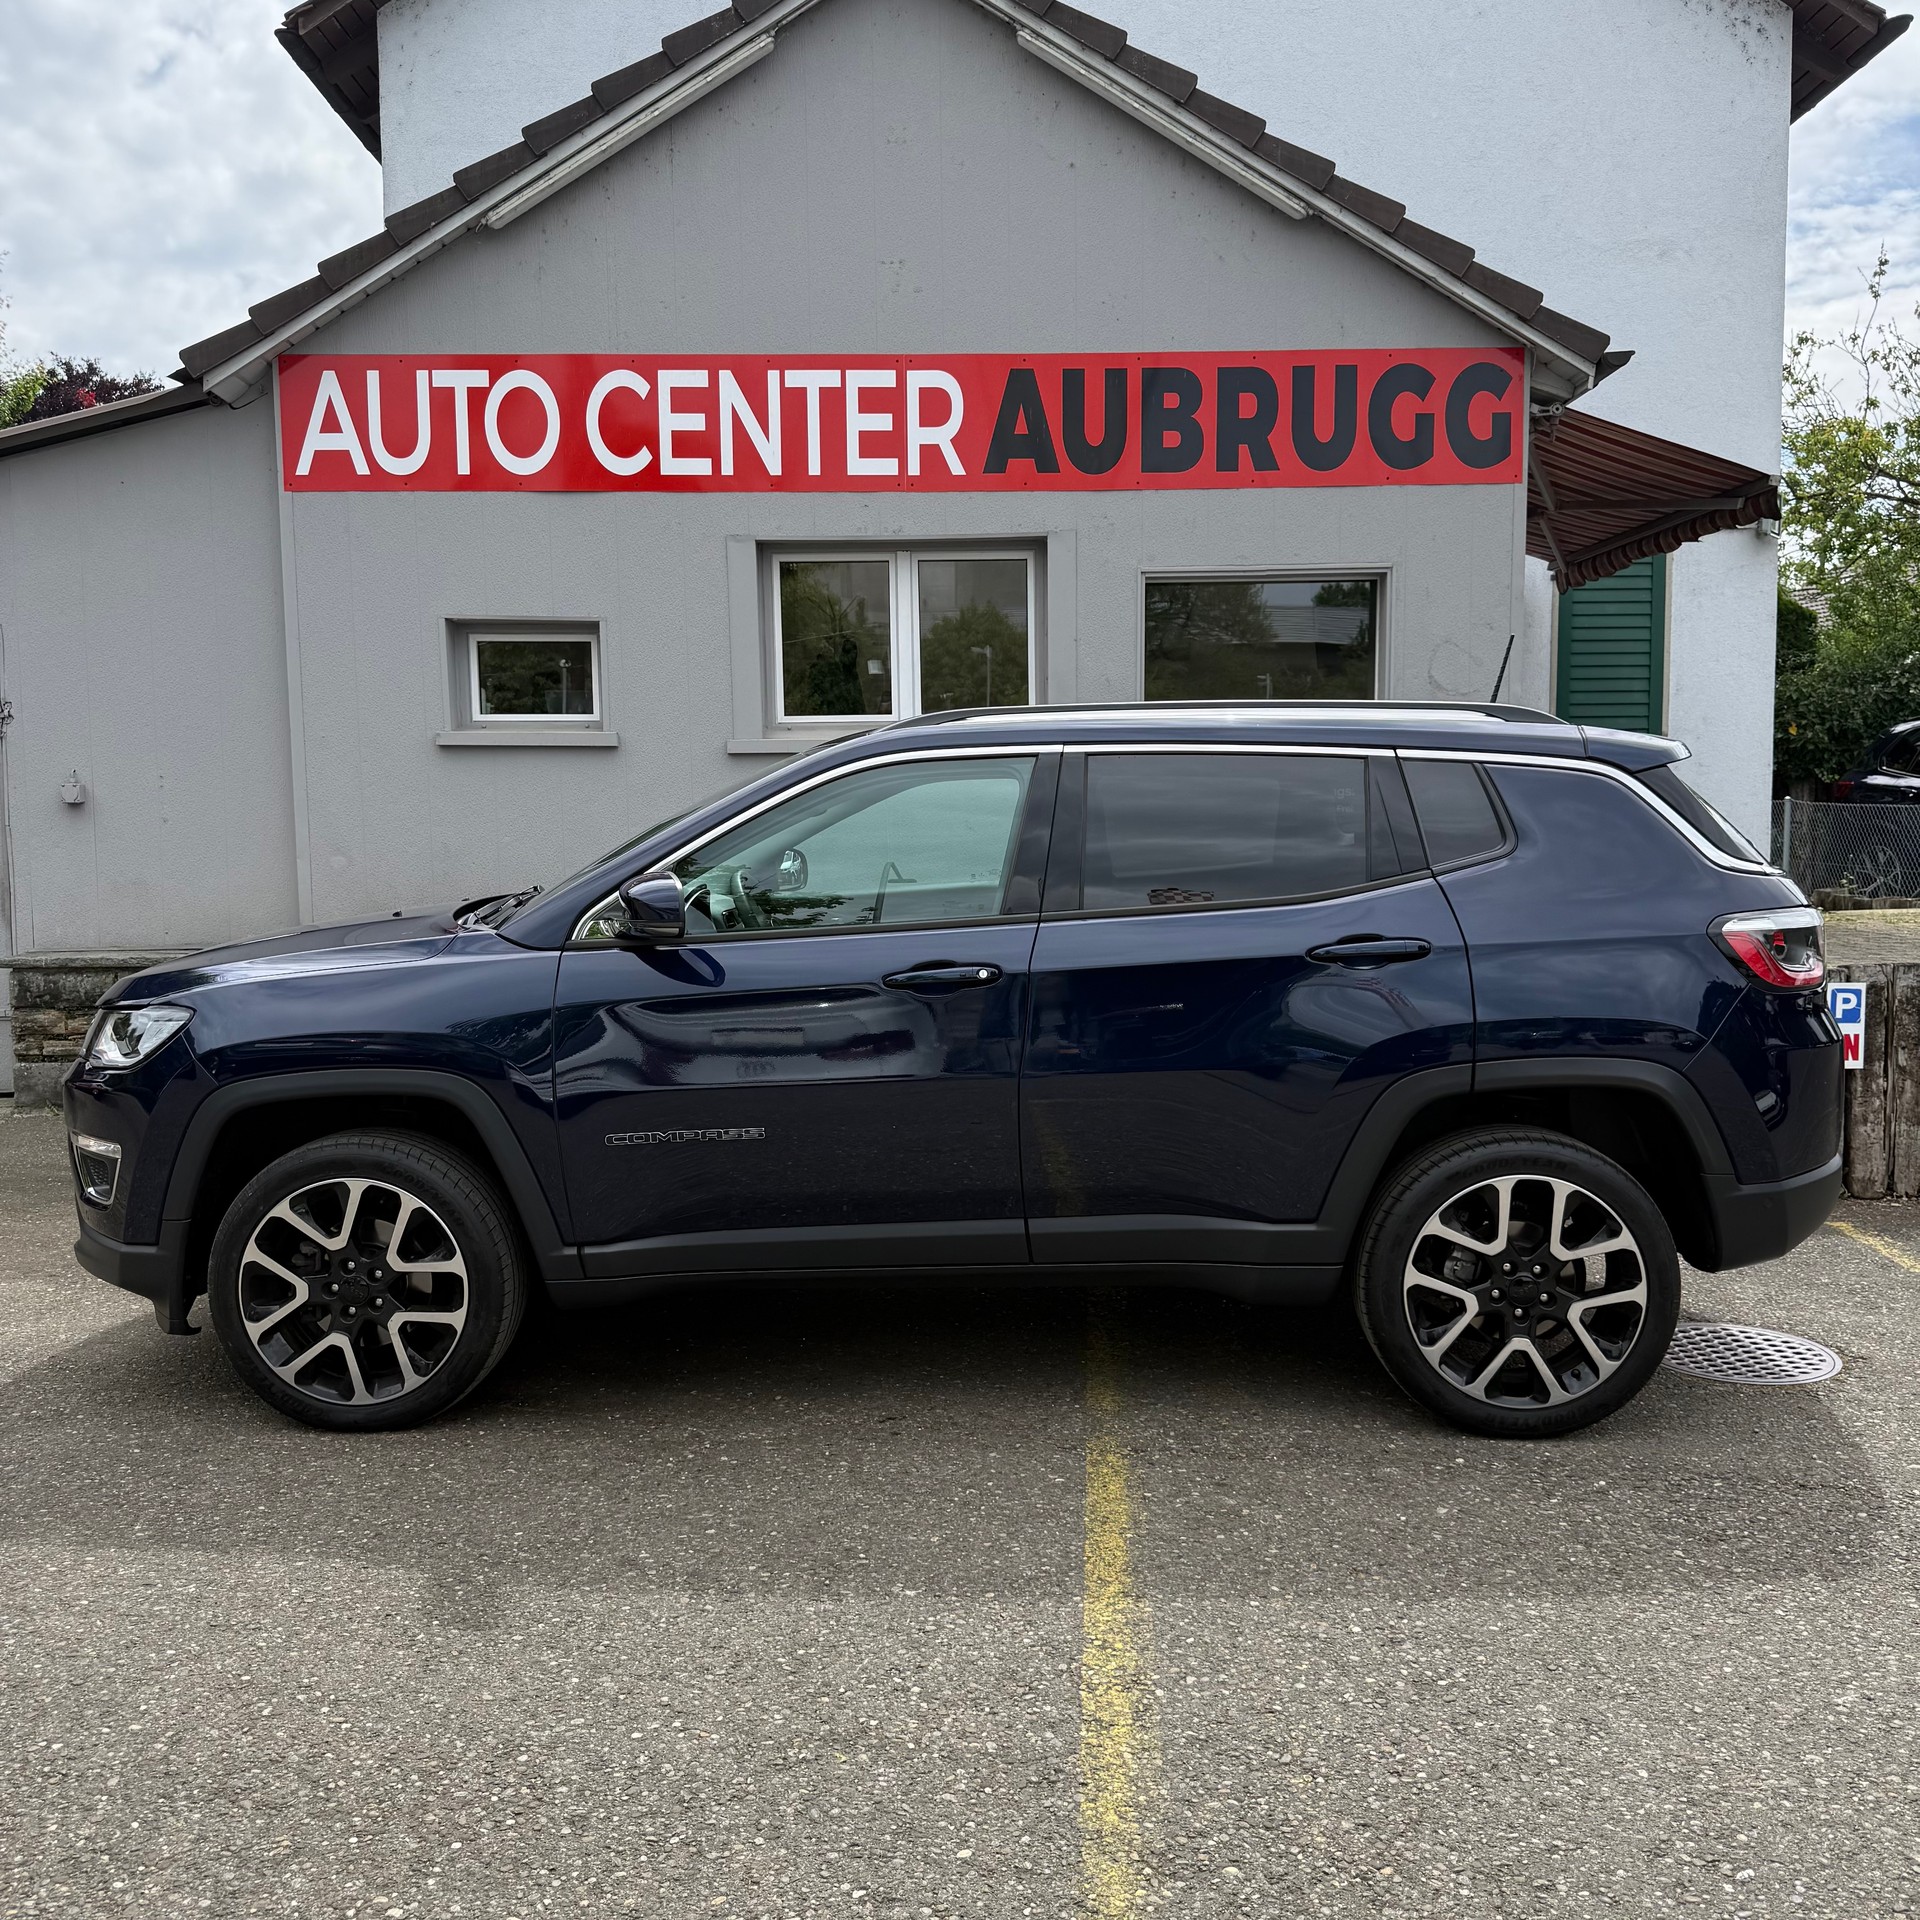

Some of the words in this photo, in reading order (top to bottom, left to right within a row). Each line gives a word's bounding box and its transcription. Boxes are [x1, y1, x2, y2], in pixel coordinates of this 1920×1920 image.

[295, 369, 561, 476] AUTO
[586, 369, 966, 476] CENTER
[982, 361, 1514, 474] AUBRUGG
[1835, 992, 1858, 1018] P
[604, 1127, 766, 1146] COMPASS
